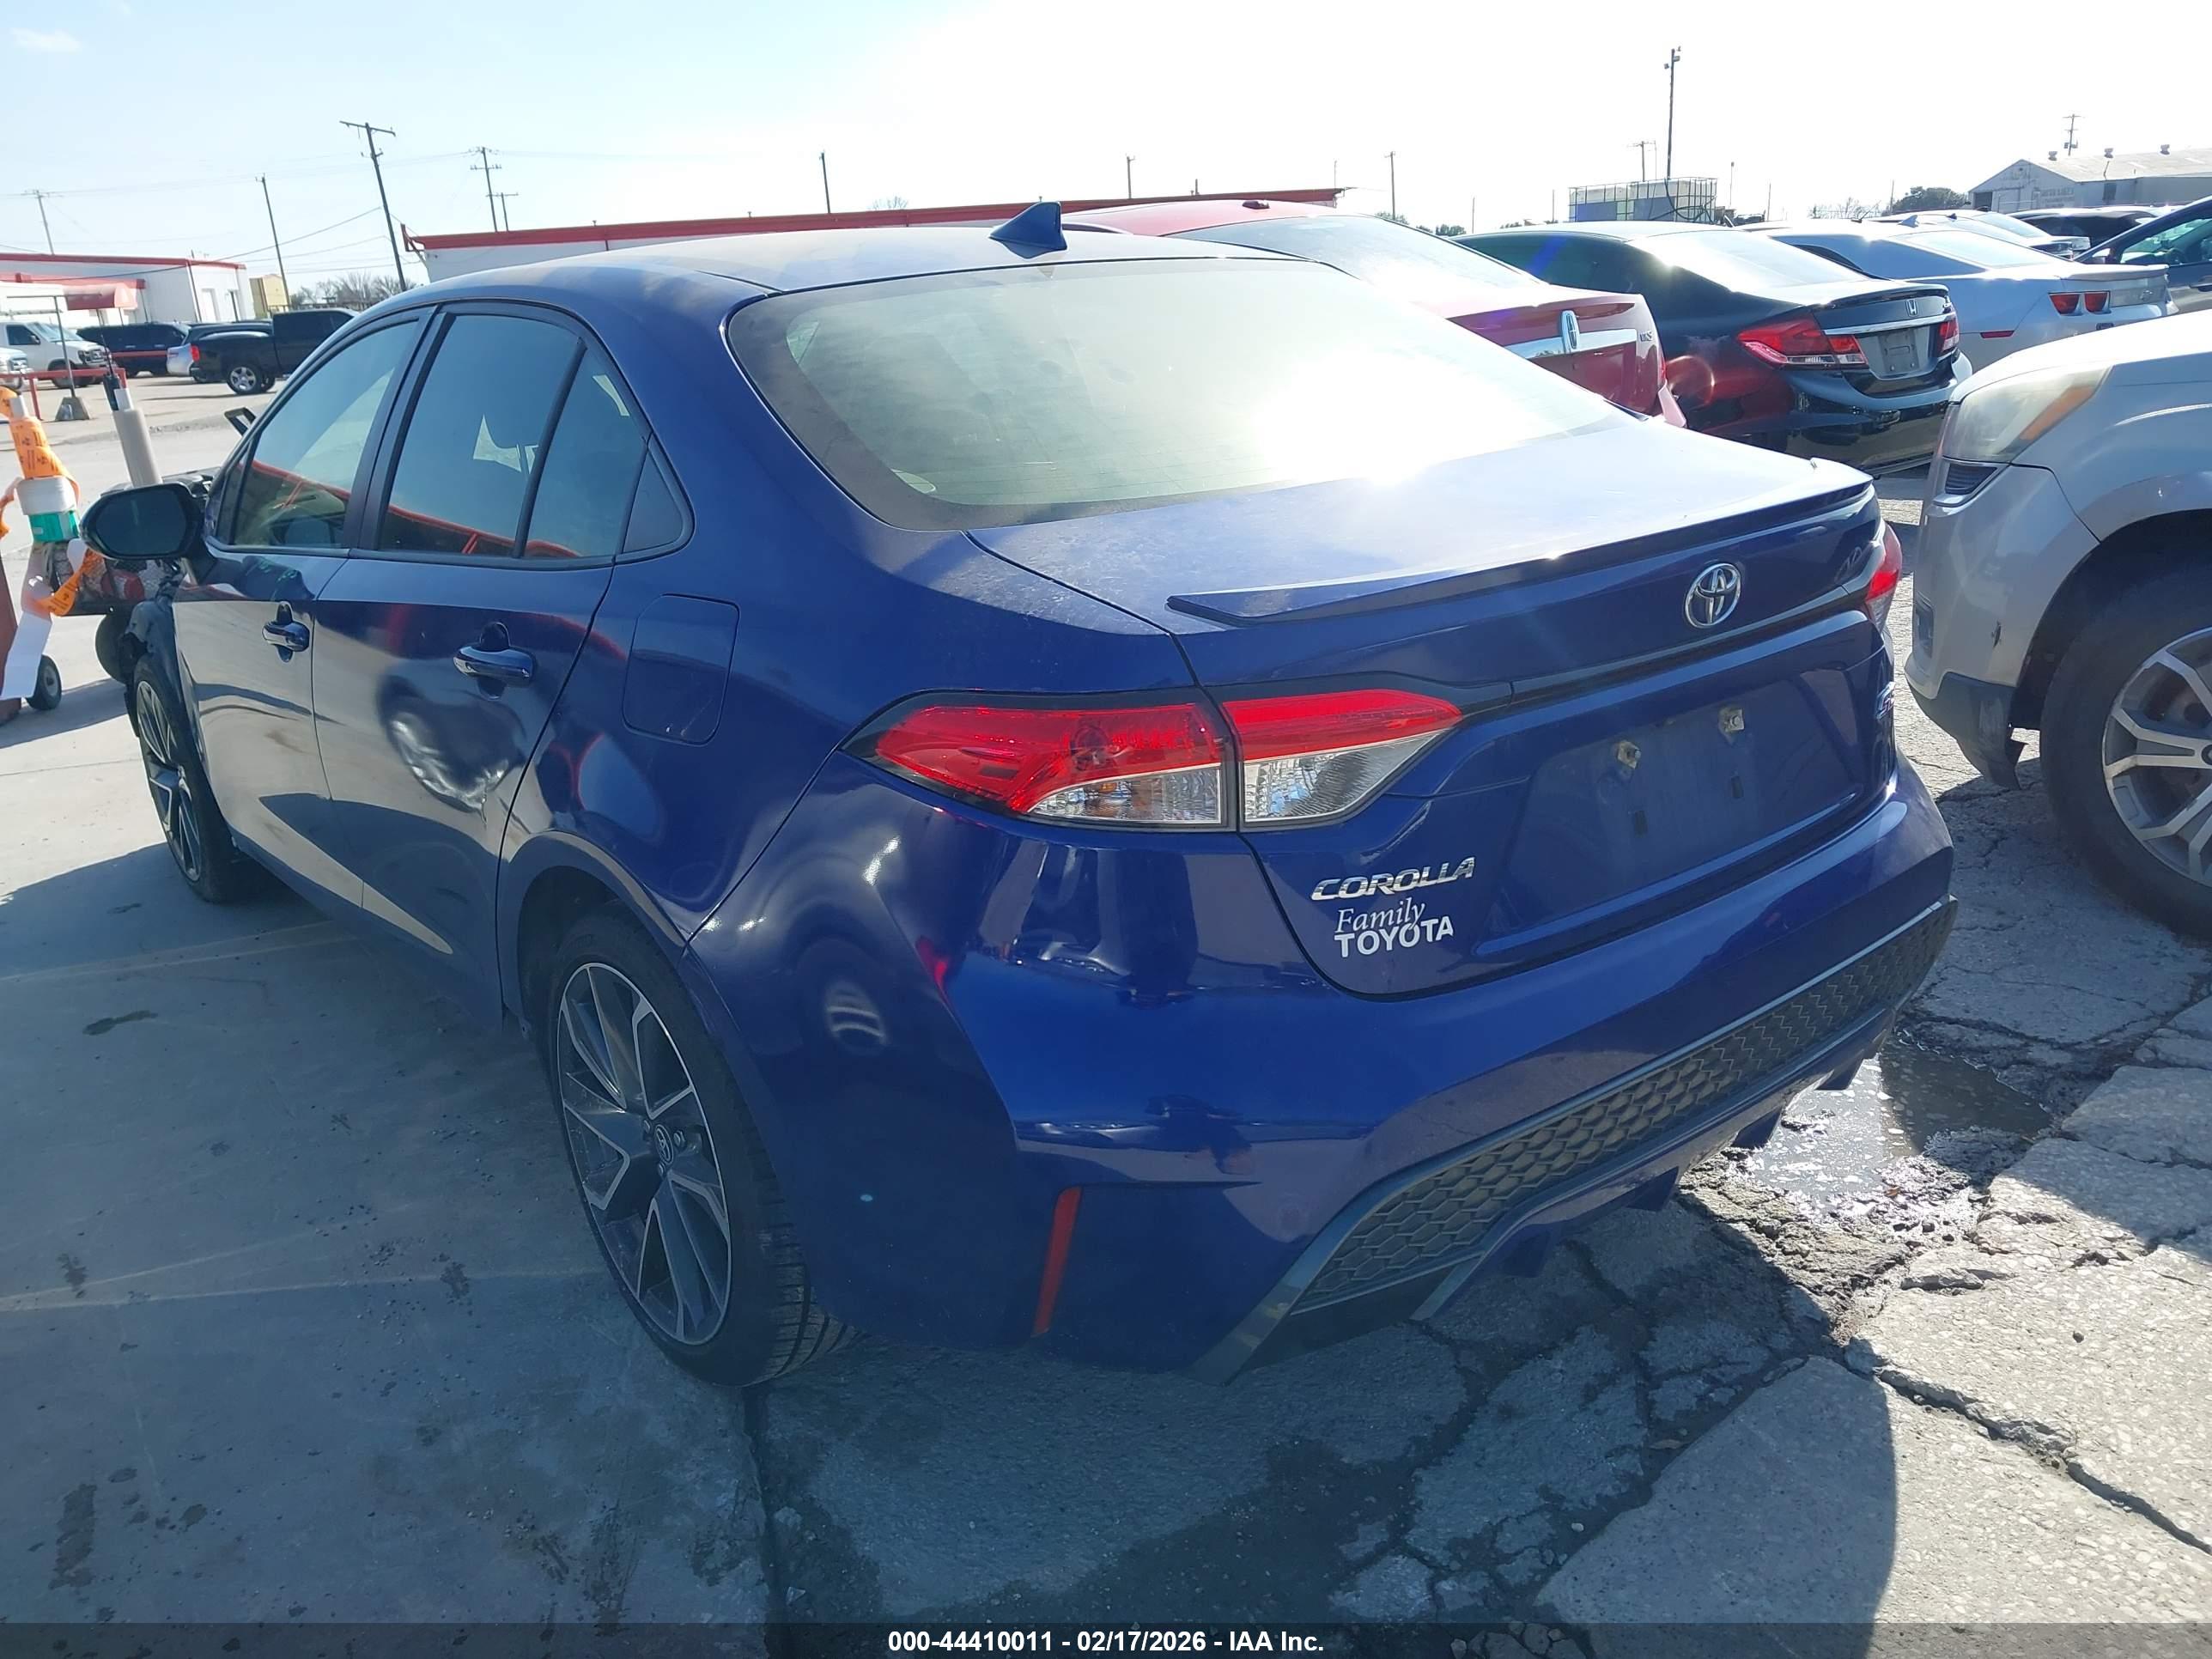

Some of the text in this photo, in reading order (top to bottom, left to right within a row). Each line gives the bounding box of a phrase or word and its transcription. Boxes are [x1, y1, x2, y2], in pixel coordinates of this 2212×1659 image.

[1311, 857, 1475, 900] COROLLA
[1334, 915, 1454, 957] TOYOTA
[1336, 898, 1425, 933] Family
